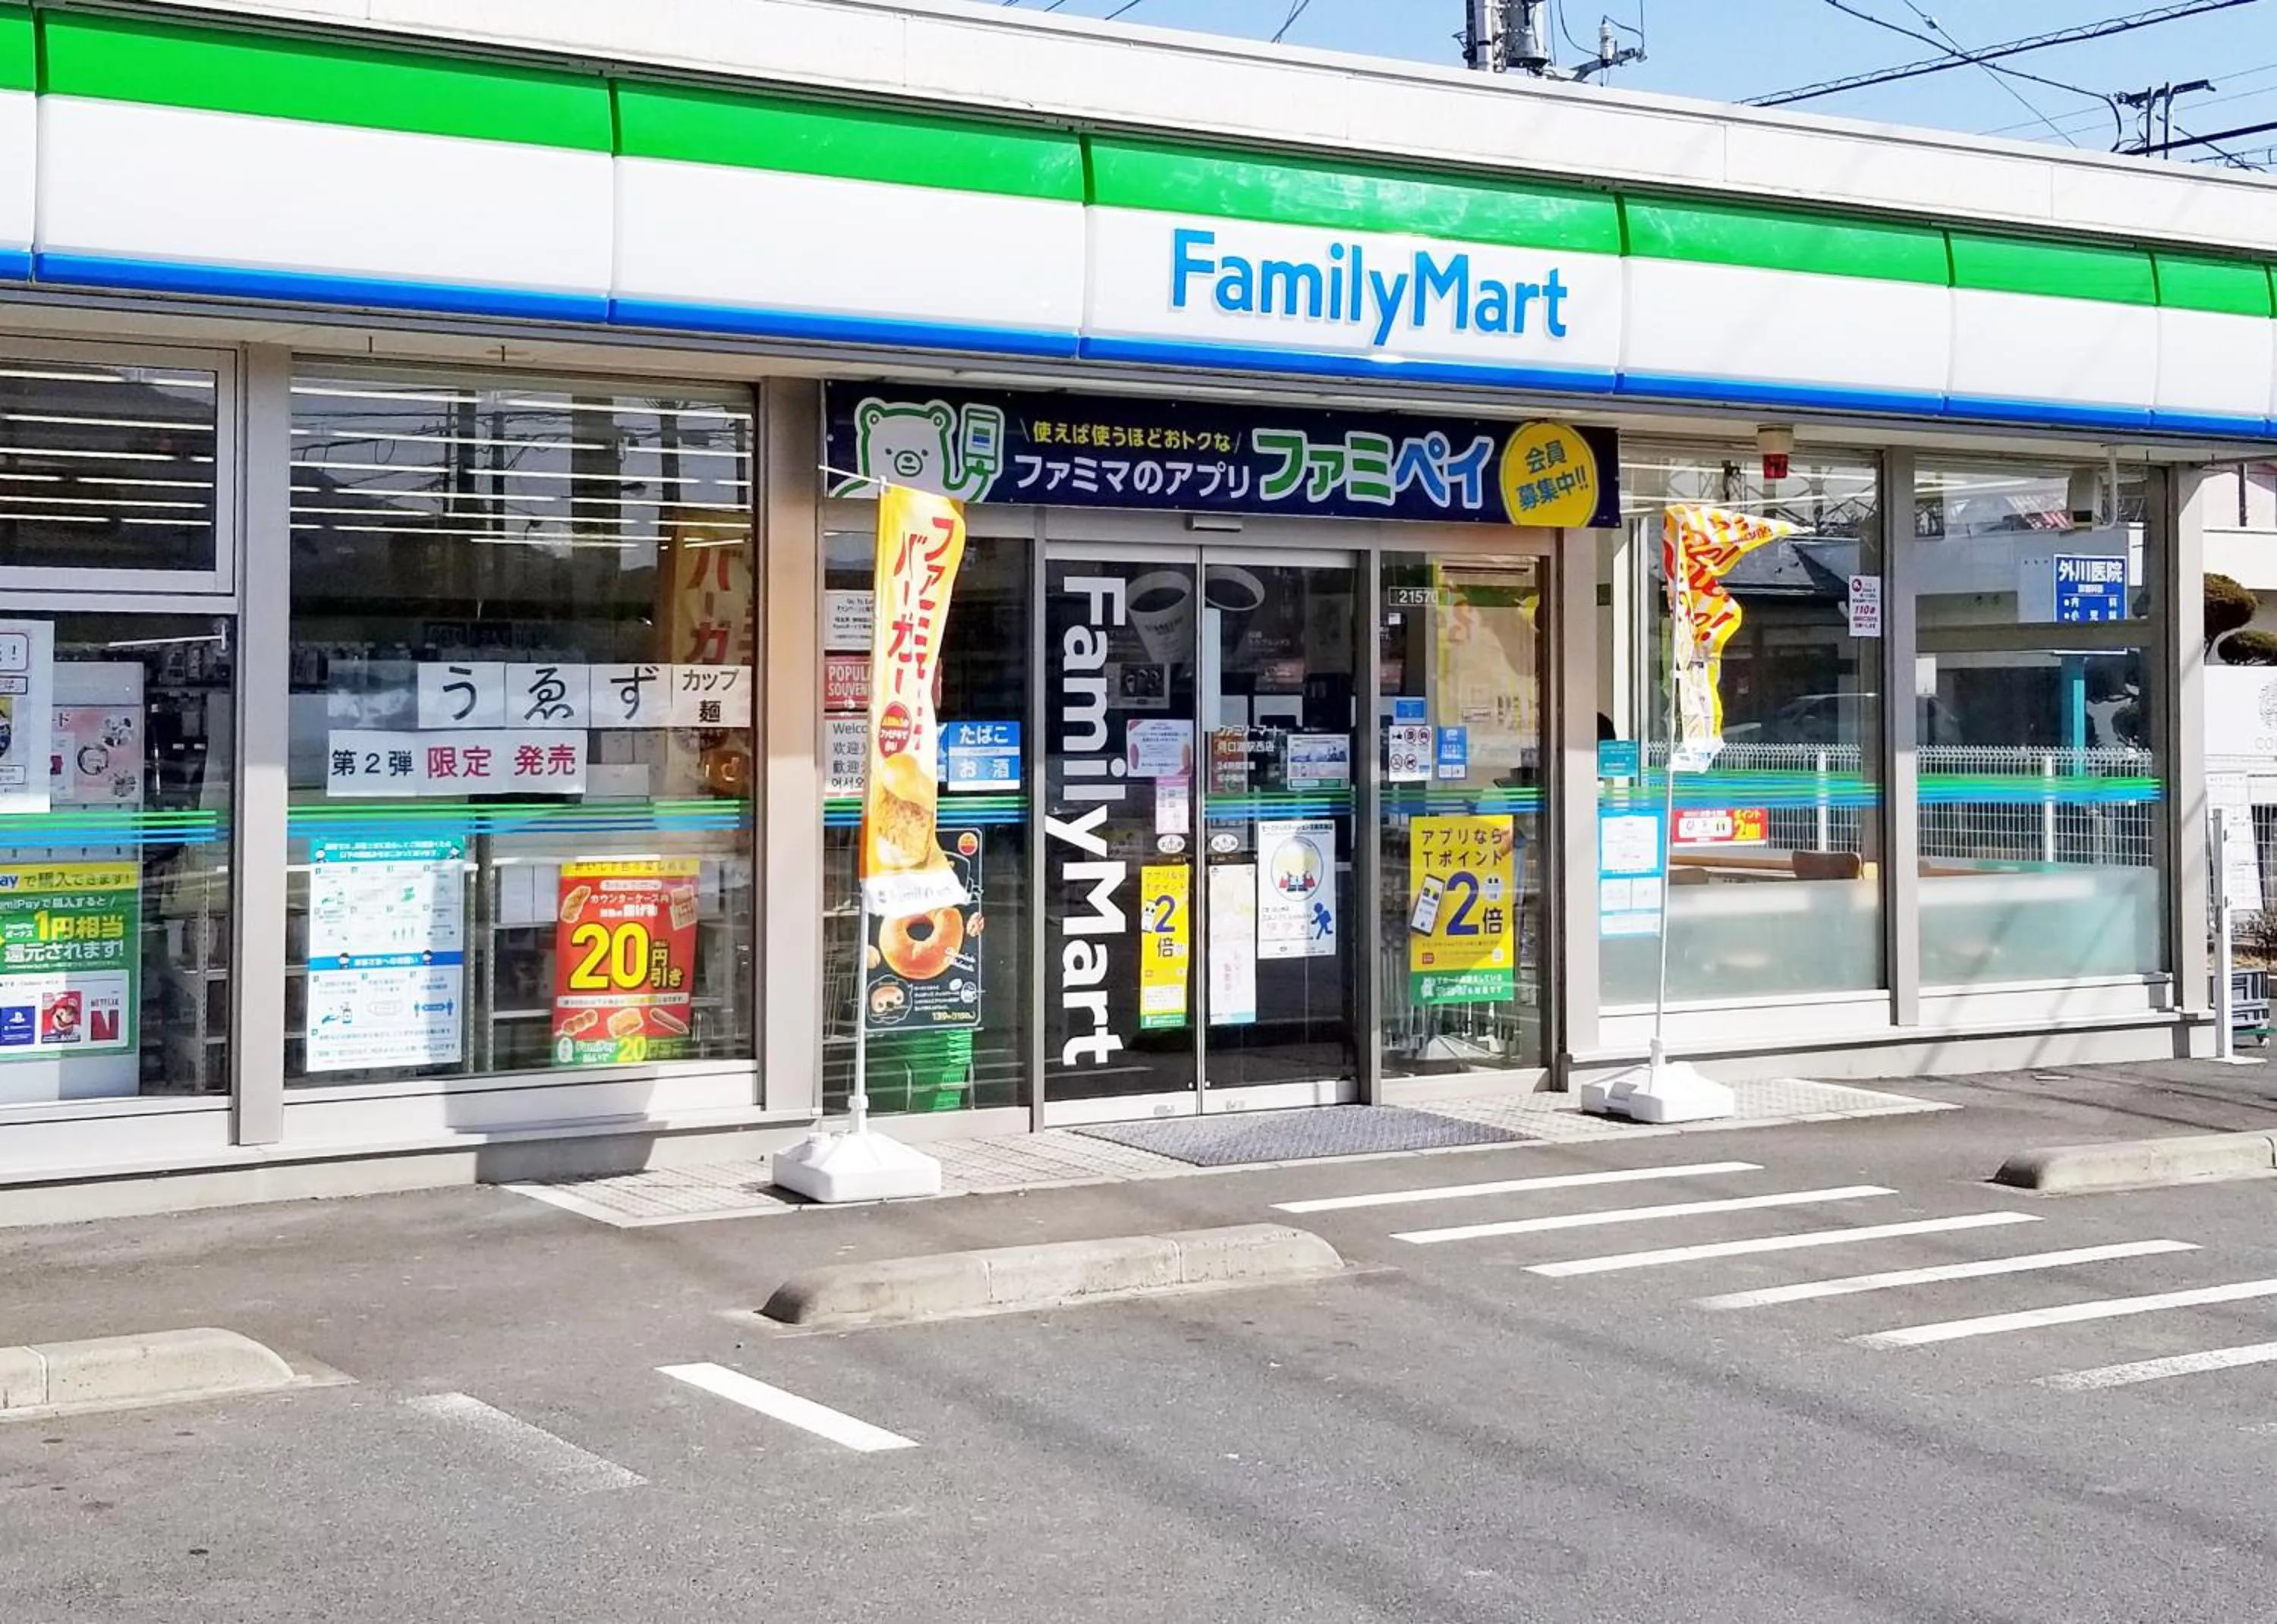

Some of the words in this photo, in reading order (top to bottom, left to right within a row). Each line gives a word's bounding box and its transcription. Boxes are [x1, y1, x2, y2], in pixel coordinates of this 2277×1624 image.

[1173, 228, 1567, 346] FamilyMart
[1033, 420, 1230, 453] 使えば使うほどおトクな
[1252, 428, 1494, 509] ファミペイ
[1525, 439, 1568, 474] 会員
[1015, 455, 1249, 499] ファミマのアプリ
[2058, 560, 2123, 583] 外川医院
[887, 530, 927, 694] バーガー
[1399, 590, 1438, 603] 21570
[682, 668, 740, 693] カップ
[959, 725, 1009, 746] たばこ
[331, 748, 414, 776] 第2弾
[1044, 576, 1127, 1066] FamilyMart
[1421, 827, 1503, 846] アプリなら
[1422, 850, 1503, 869] Tポイント
[1154, 895, 1176, 933] 2
[1446, 870, 1479, 936] 2
[1482, 907, 1504, 935] 倍
[570, 921, 649, 989] 20
[1157, 936, 1174, 958] 倍
